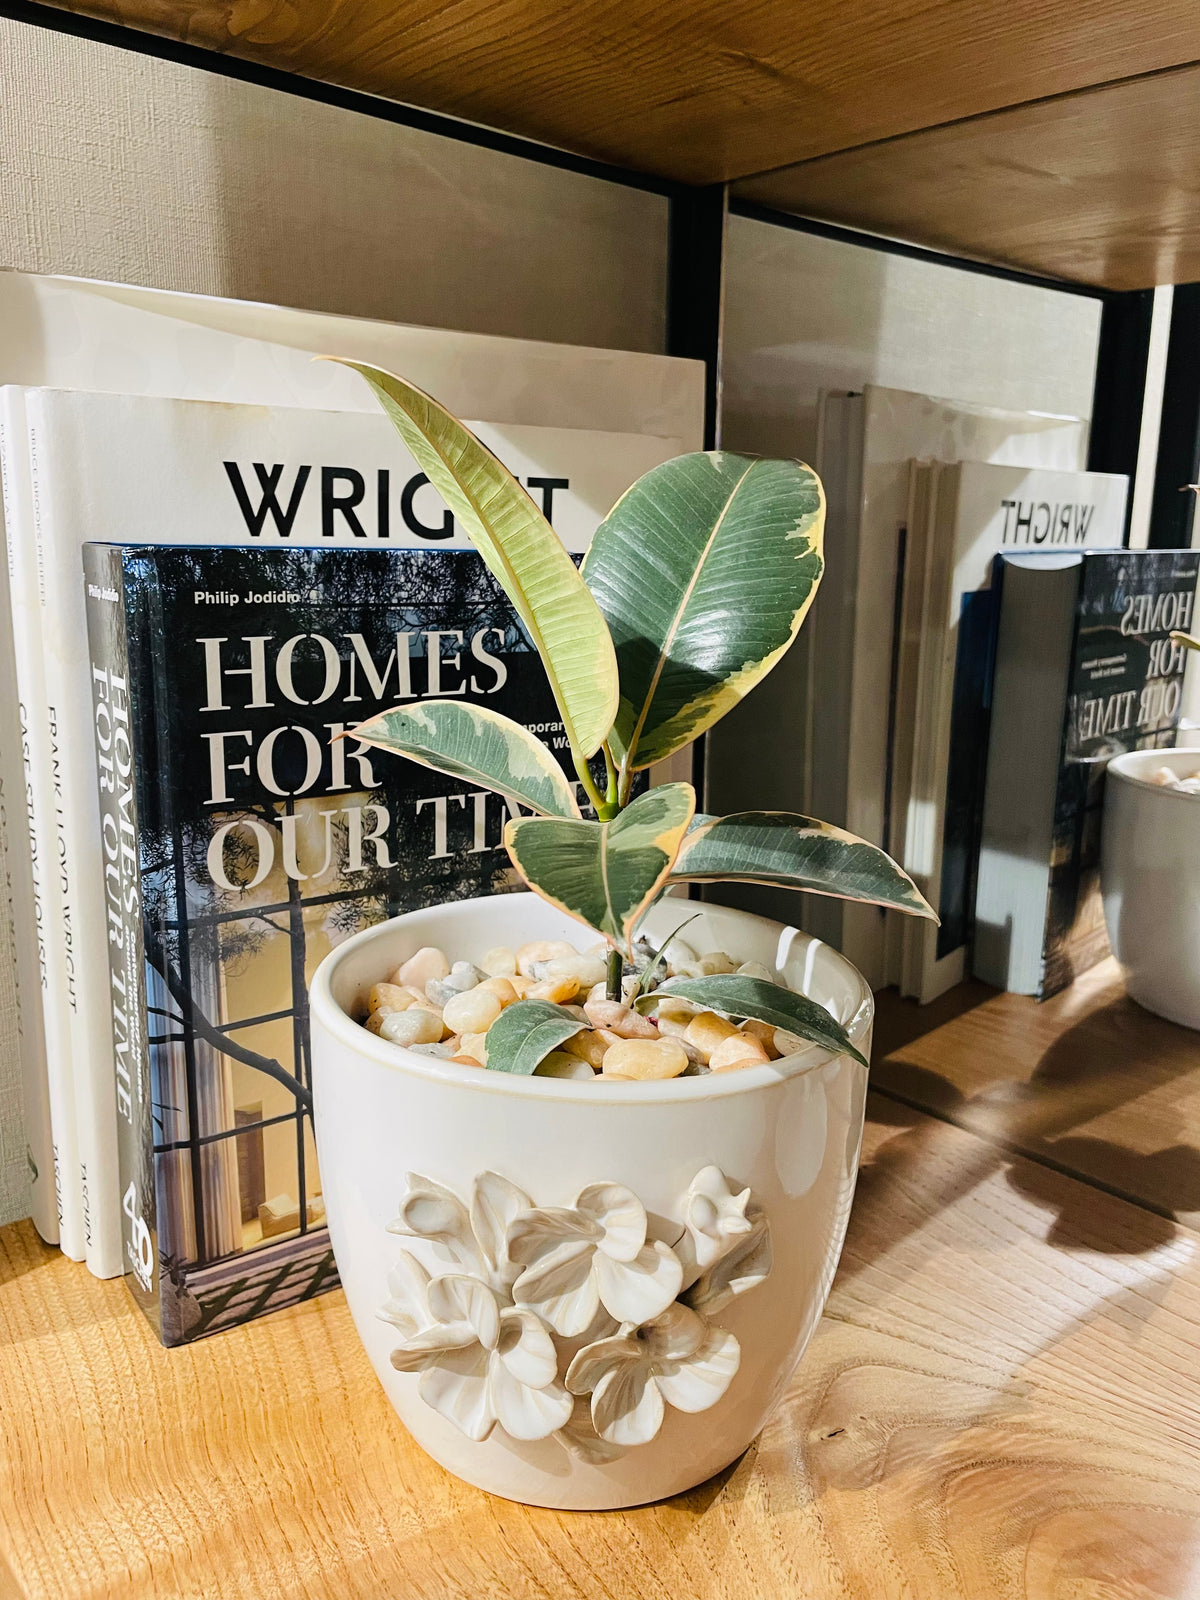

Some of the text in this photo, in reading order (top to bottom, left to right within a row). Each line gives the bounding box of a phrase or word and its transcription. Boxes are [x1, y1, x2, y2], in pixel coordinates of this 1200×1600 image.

[223, 461, 570, 540] WRIGT
[194, 590, 300, 606] Philip Jodidio
[195, 627, 508, 712] HOMES
[19, 701, 31, 773] CASE
[25, 783, 39, 874] STUDY
[109, 667, 139, 918] HOMES
[199, 721, 382, 805] FOR
[48, 705, 78, 1014] FRANK LLOYD WRIGHT
[205, 805, 398, 892] OUR
[93, 662, 132, 1126] FOR OUR TIME
[80, 1162, 93, 1248] TASCHEN
